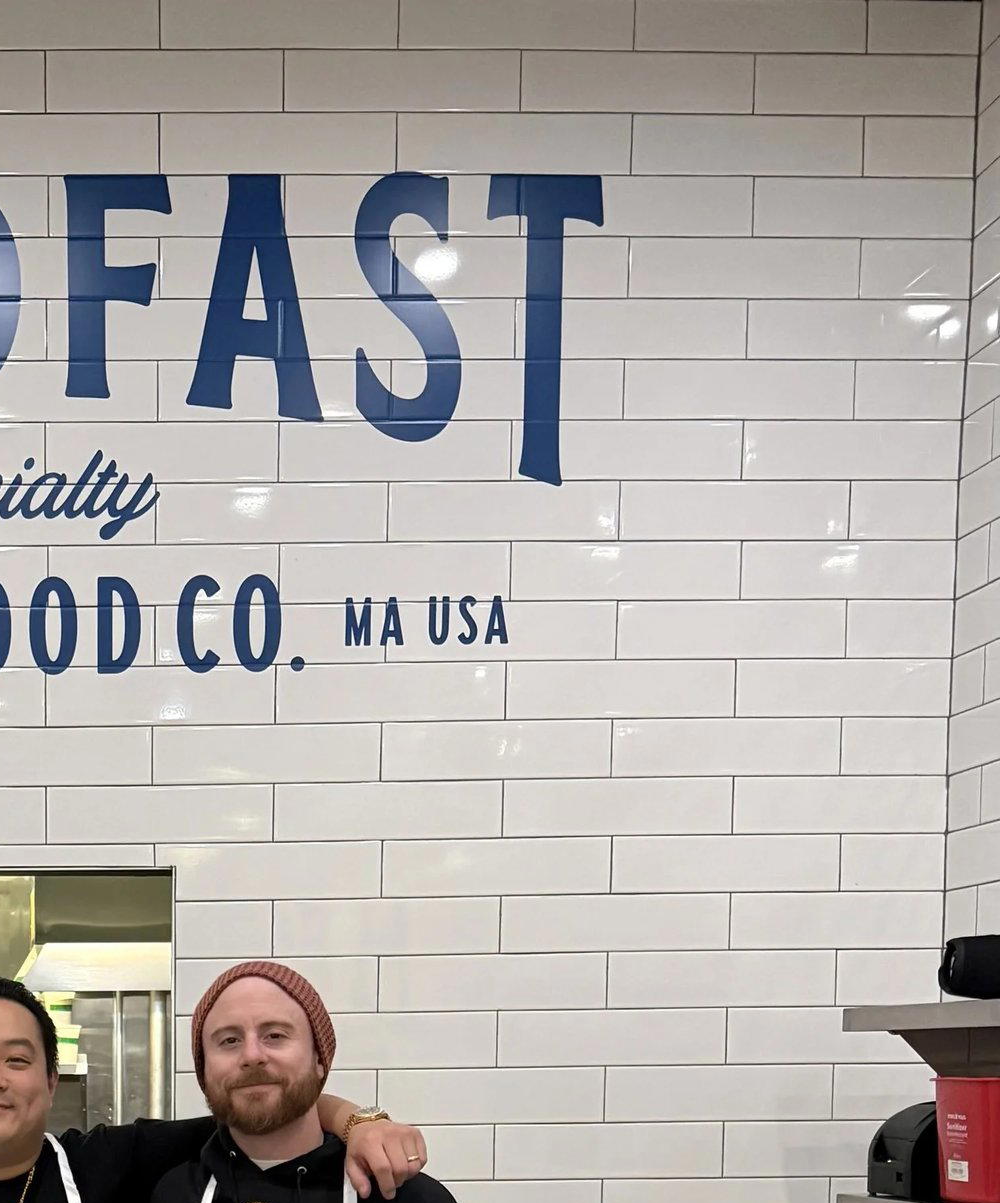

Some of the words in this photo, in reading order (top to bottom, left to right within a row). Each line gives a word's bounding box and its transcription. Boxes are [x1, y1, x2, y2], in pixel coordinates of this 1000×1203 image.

[176, 574, 306, 673] CO.
[344, 597, 404, 647] MA
[428, 595, 509, 645] USA
